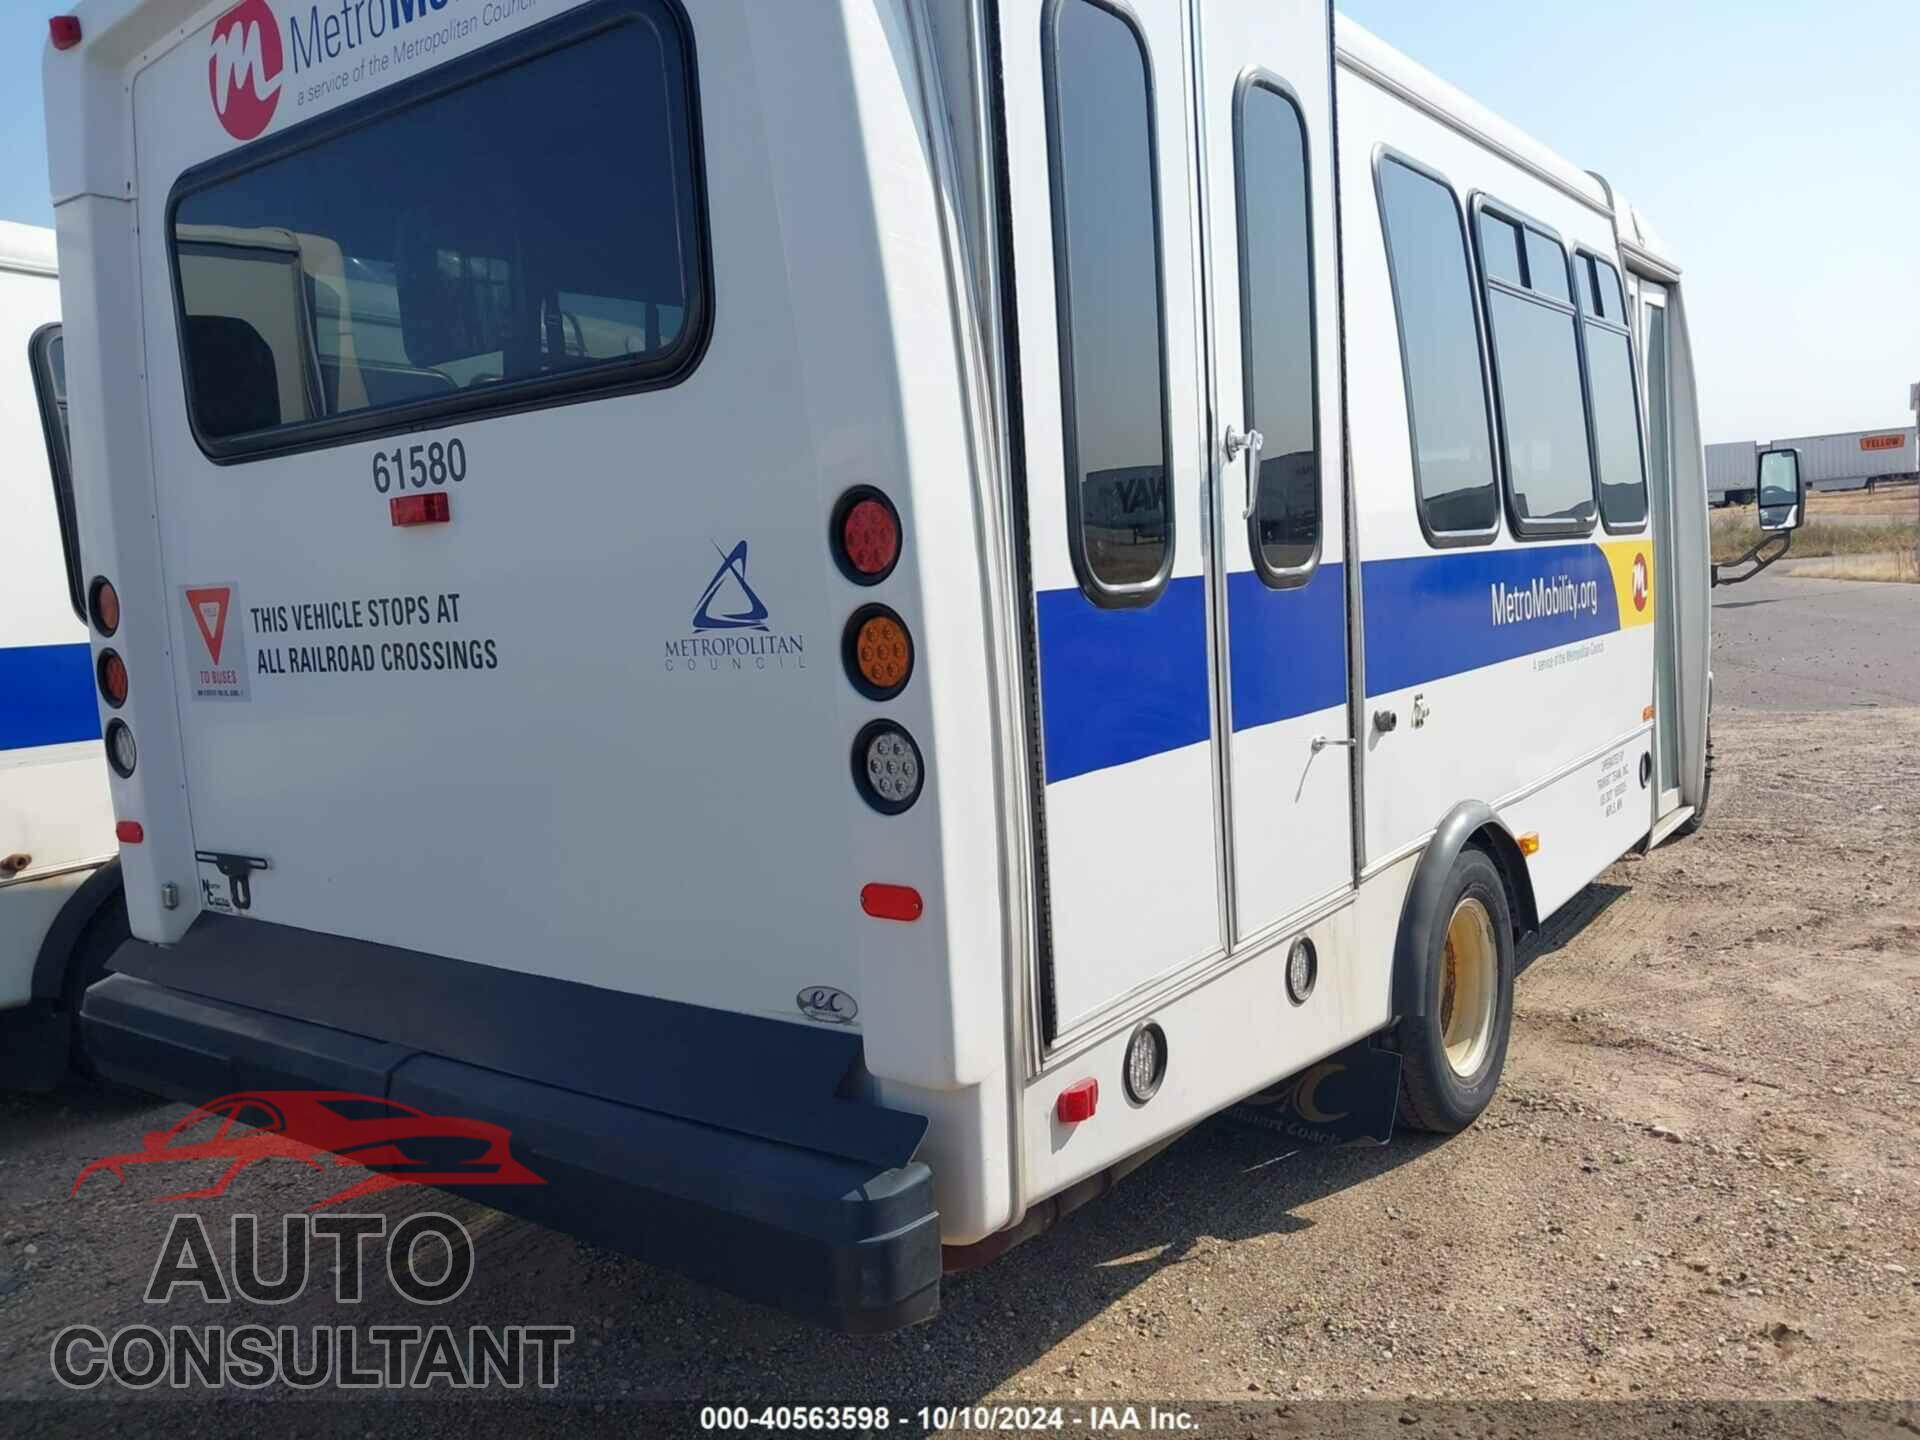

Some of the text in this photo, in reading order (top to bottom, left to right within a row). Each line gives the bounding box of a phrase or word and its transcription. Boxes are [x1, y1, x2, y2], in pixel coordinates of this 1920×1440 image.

[297, 0, 536, 106] a service of the Metropolitan Counc
[1863, 436, 1900, 449] YELLOW
[373, 438, 466, 493] 61580
[250, 593, 460, 633] THIS VEHICLE STOPS AT
[1491, 575, 1597, 626] MetroMobility.org
[258, 639, 498, 674] ALL RAILROAD CROSSINGS
[665, 635, 804, 657] METROPOLITAN
[665, 656, 807, 672] COUNCIL
